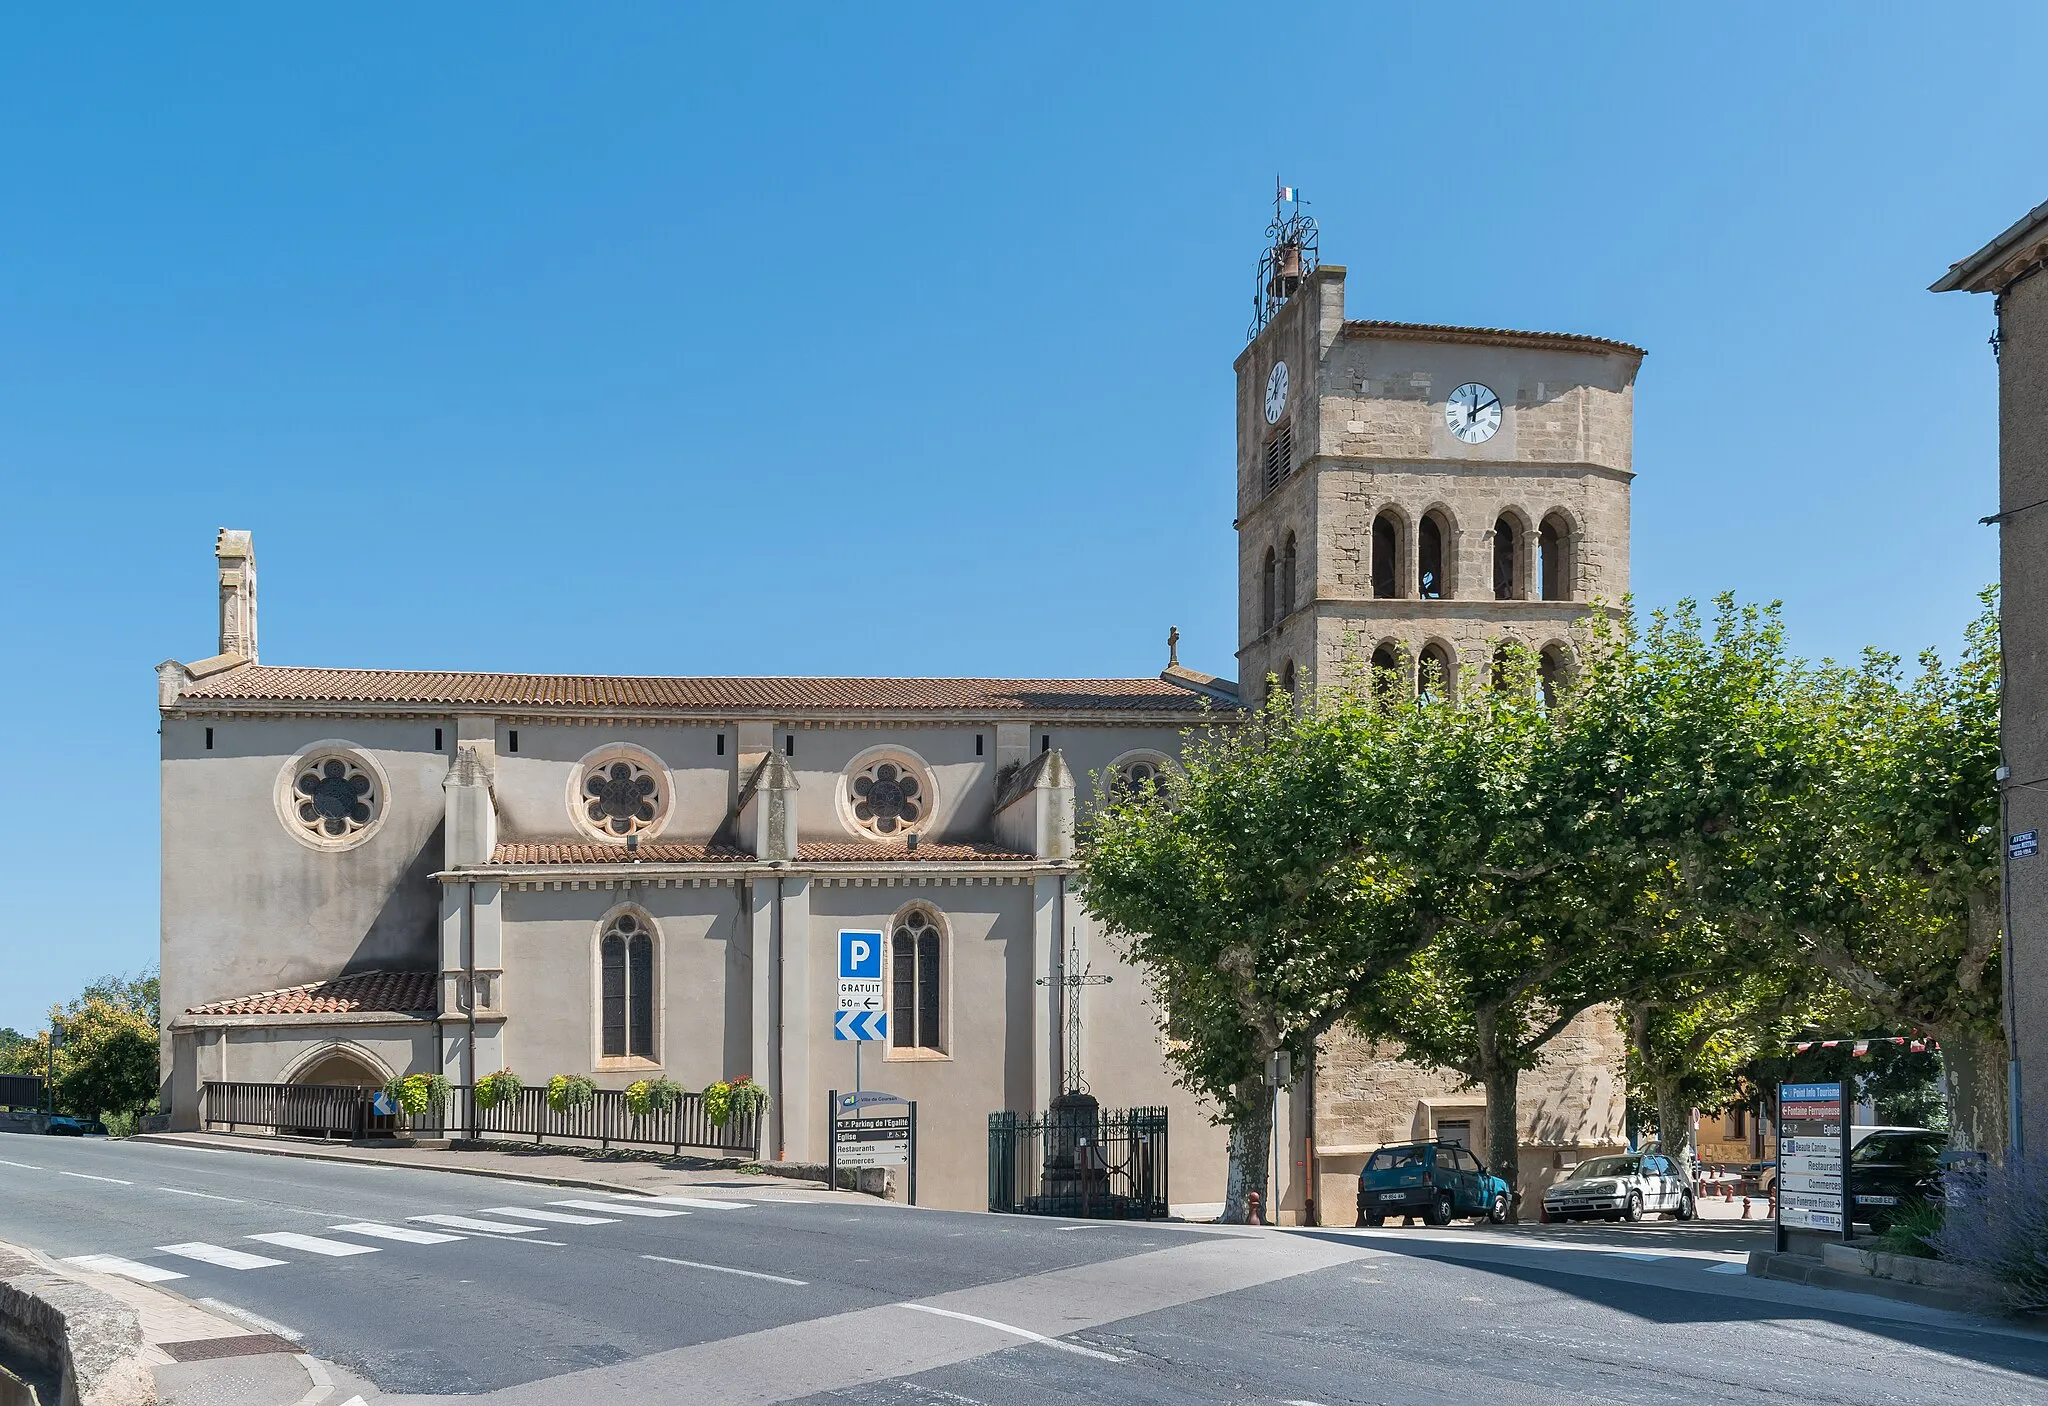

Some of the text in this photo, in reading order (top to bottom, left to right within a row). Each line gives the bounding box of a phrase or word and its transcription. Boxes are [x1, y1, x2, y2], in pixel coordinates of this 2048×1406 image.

[851, 940, 870, 970] P
[841, 983, 881, 993] GRATUIT
[841, 998, 853, 1008] 50
[1793, 1086, 1840, 1098] Point Info Tourisme
[1787, 1105, 1840, 1117] Fontaine Ferrugineuse
[851, 1120, 875, 1129] Parking
[875, 1119, 883, 1128] de
[884, 1118, 909, 1128] l'Egalité
[1823, 1124, 1841, 1135] Eglise
[837, 1133, 857, 1142] Eglise
[837, 1144, 876, 1153] Restaurants
[837, 1157, 875, 1166] Commerces
[1807, 1160, 1842, 1172] Restaurants
[1808, 1178, 1842, 1191] Commerces
[1811, 1214, 1830, 1224] SUPER
[1830, 1216, 1836, 1225] U
